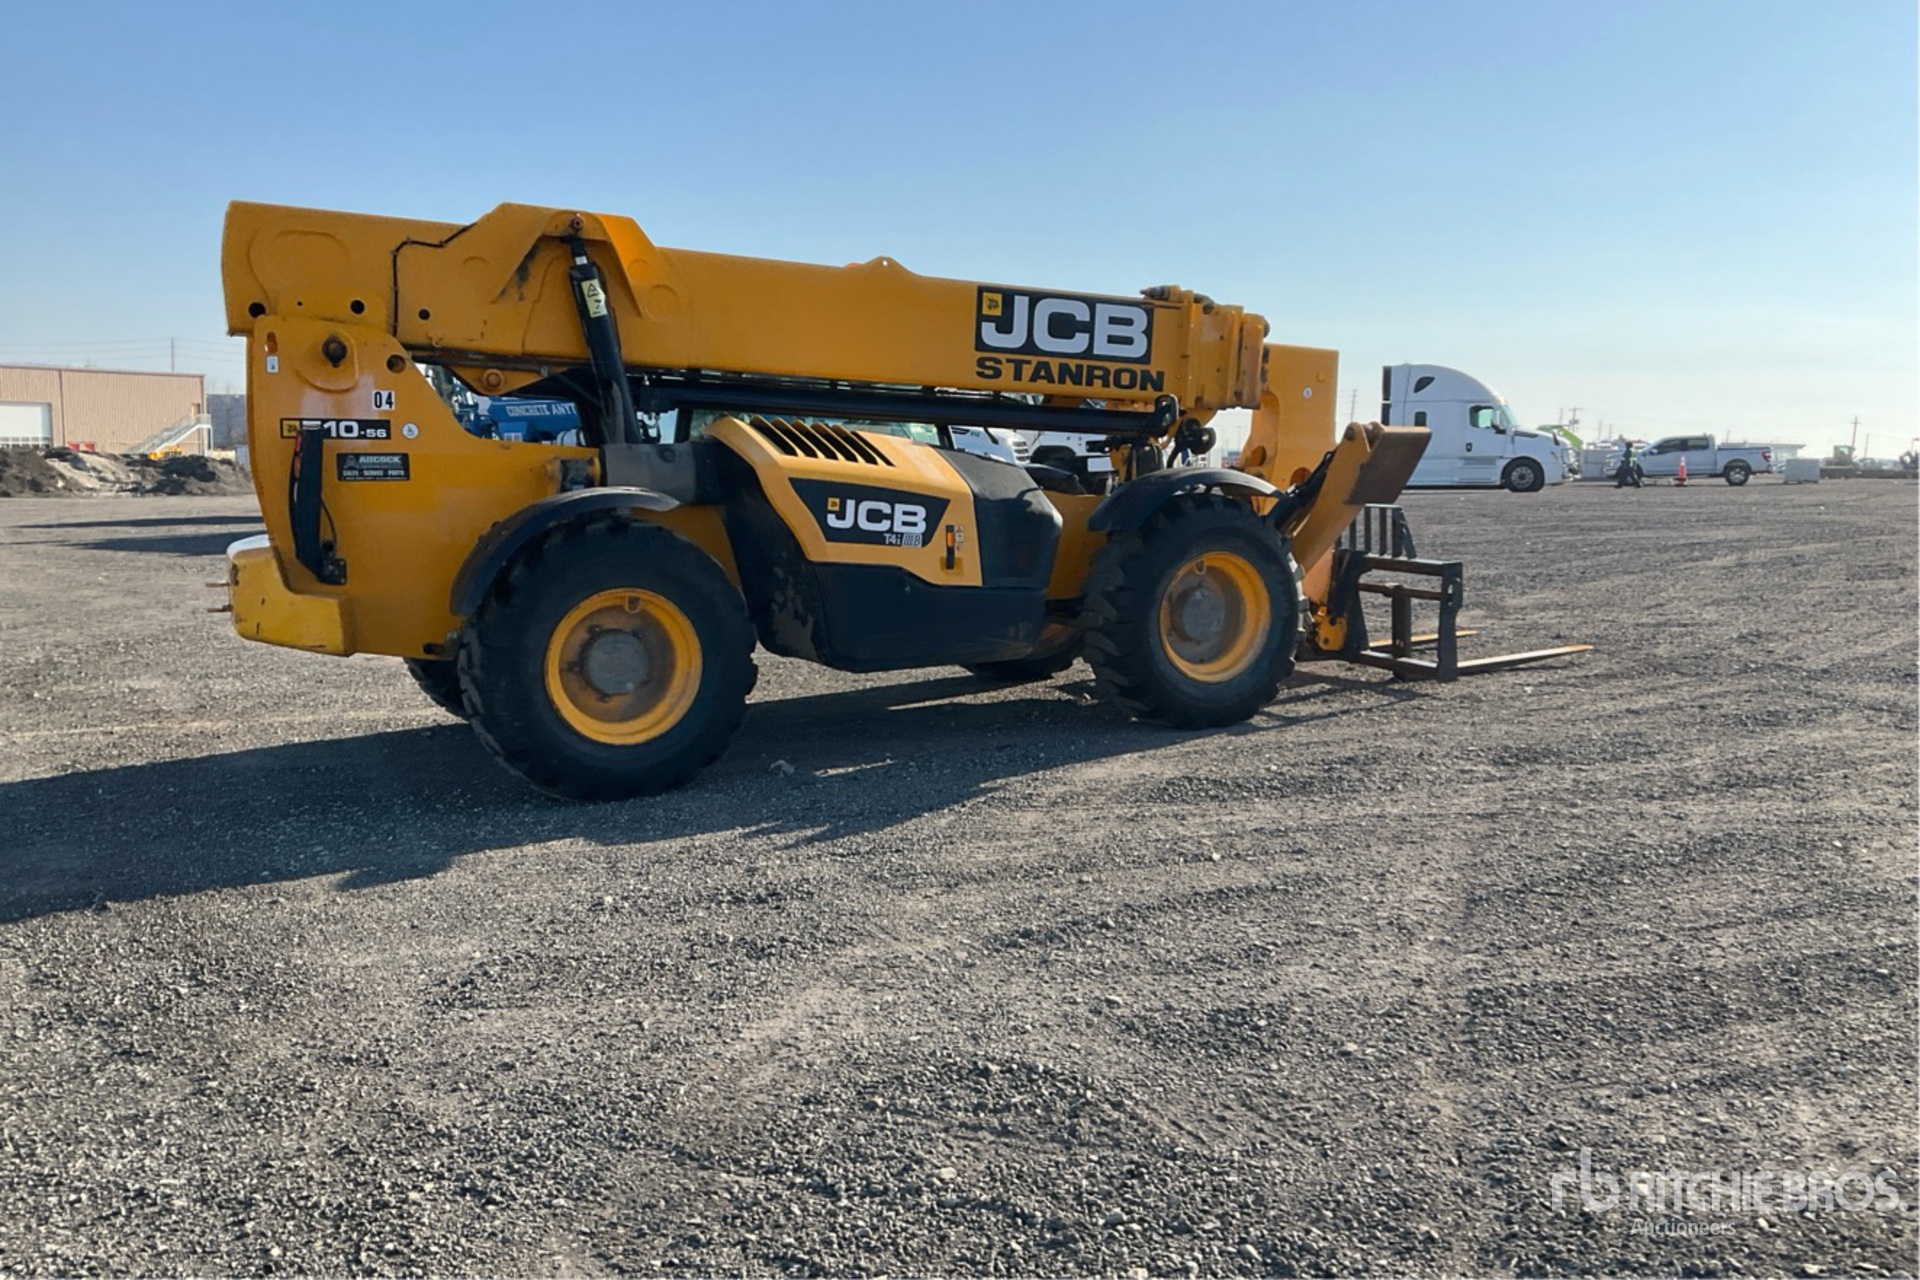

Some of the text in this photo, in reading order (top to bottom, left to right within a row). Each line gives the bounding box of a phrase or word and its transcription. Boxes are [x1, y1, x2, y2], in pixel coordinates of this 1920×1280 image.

[981, 295, 1148, 358] JCB
[976, 356, 1164, 391] STANRON
[374, 391, 393, 408] 04
[827, 499, 926, 533] JCB
